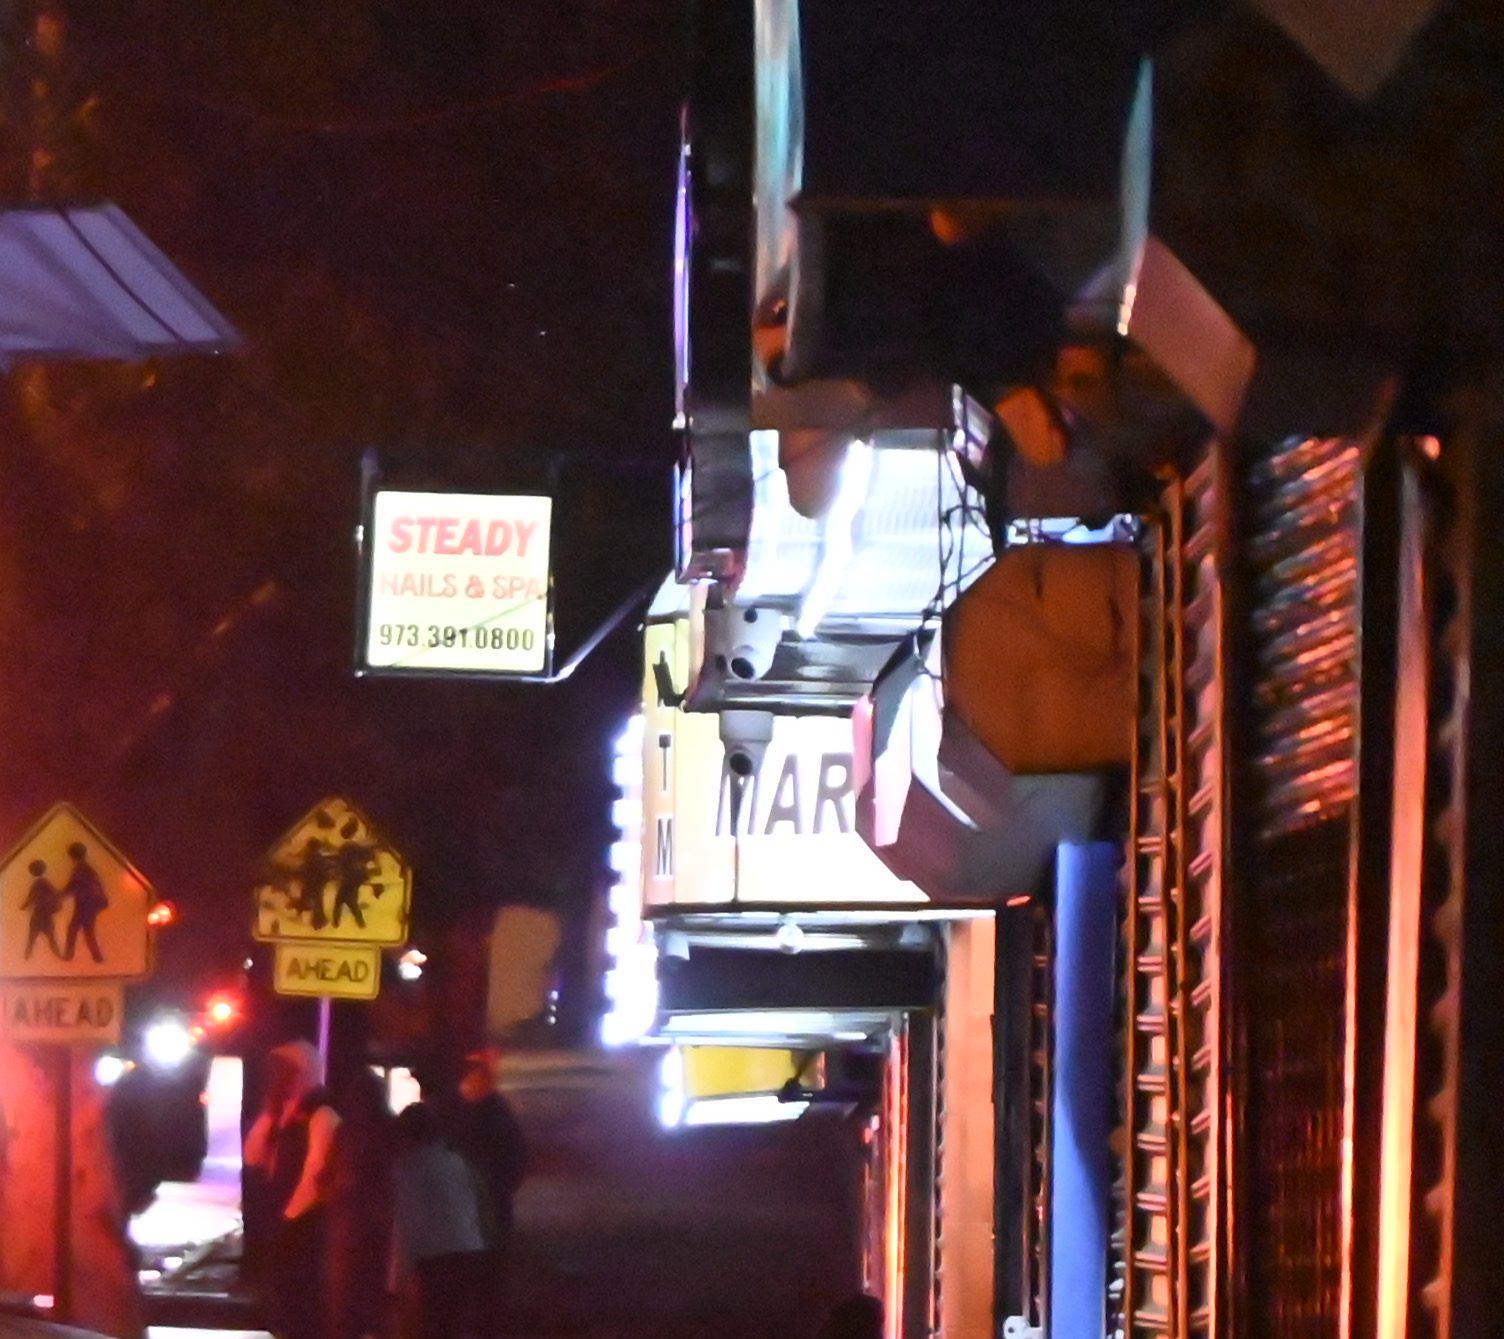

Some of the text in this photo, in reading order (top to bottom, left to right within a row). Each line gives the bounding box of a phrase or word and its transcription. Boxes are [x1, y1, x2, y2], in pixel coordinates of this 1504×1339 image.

[388, 516, 538, 557] STEADY
[381, 572, 542, 600] NAILS & SPA
[656, 650, 675, 877] TM
[285, 960, 370, 984] AHEAD
[10, 995, 116, 1029] AHEAD
